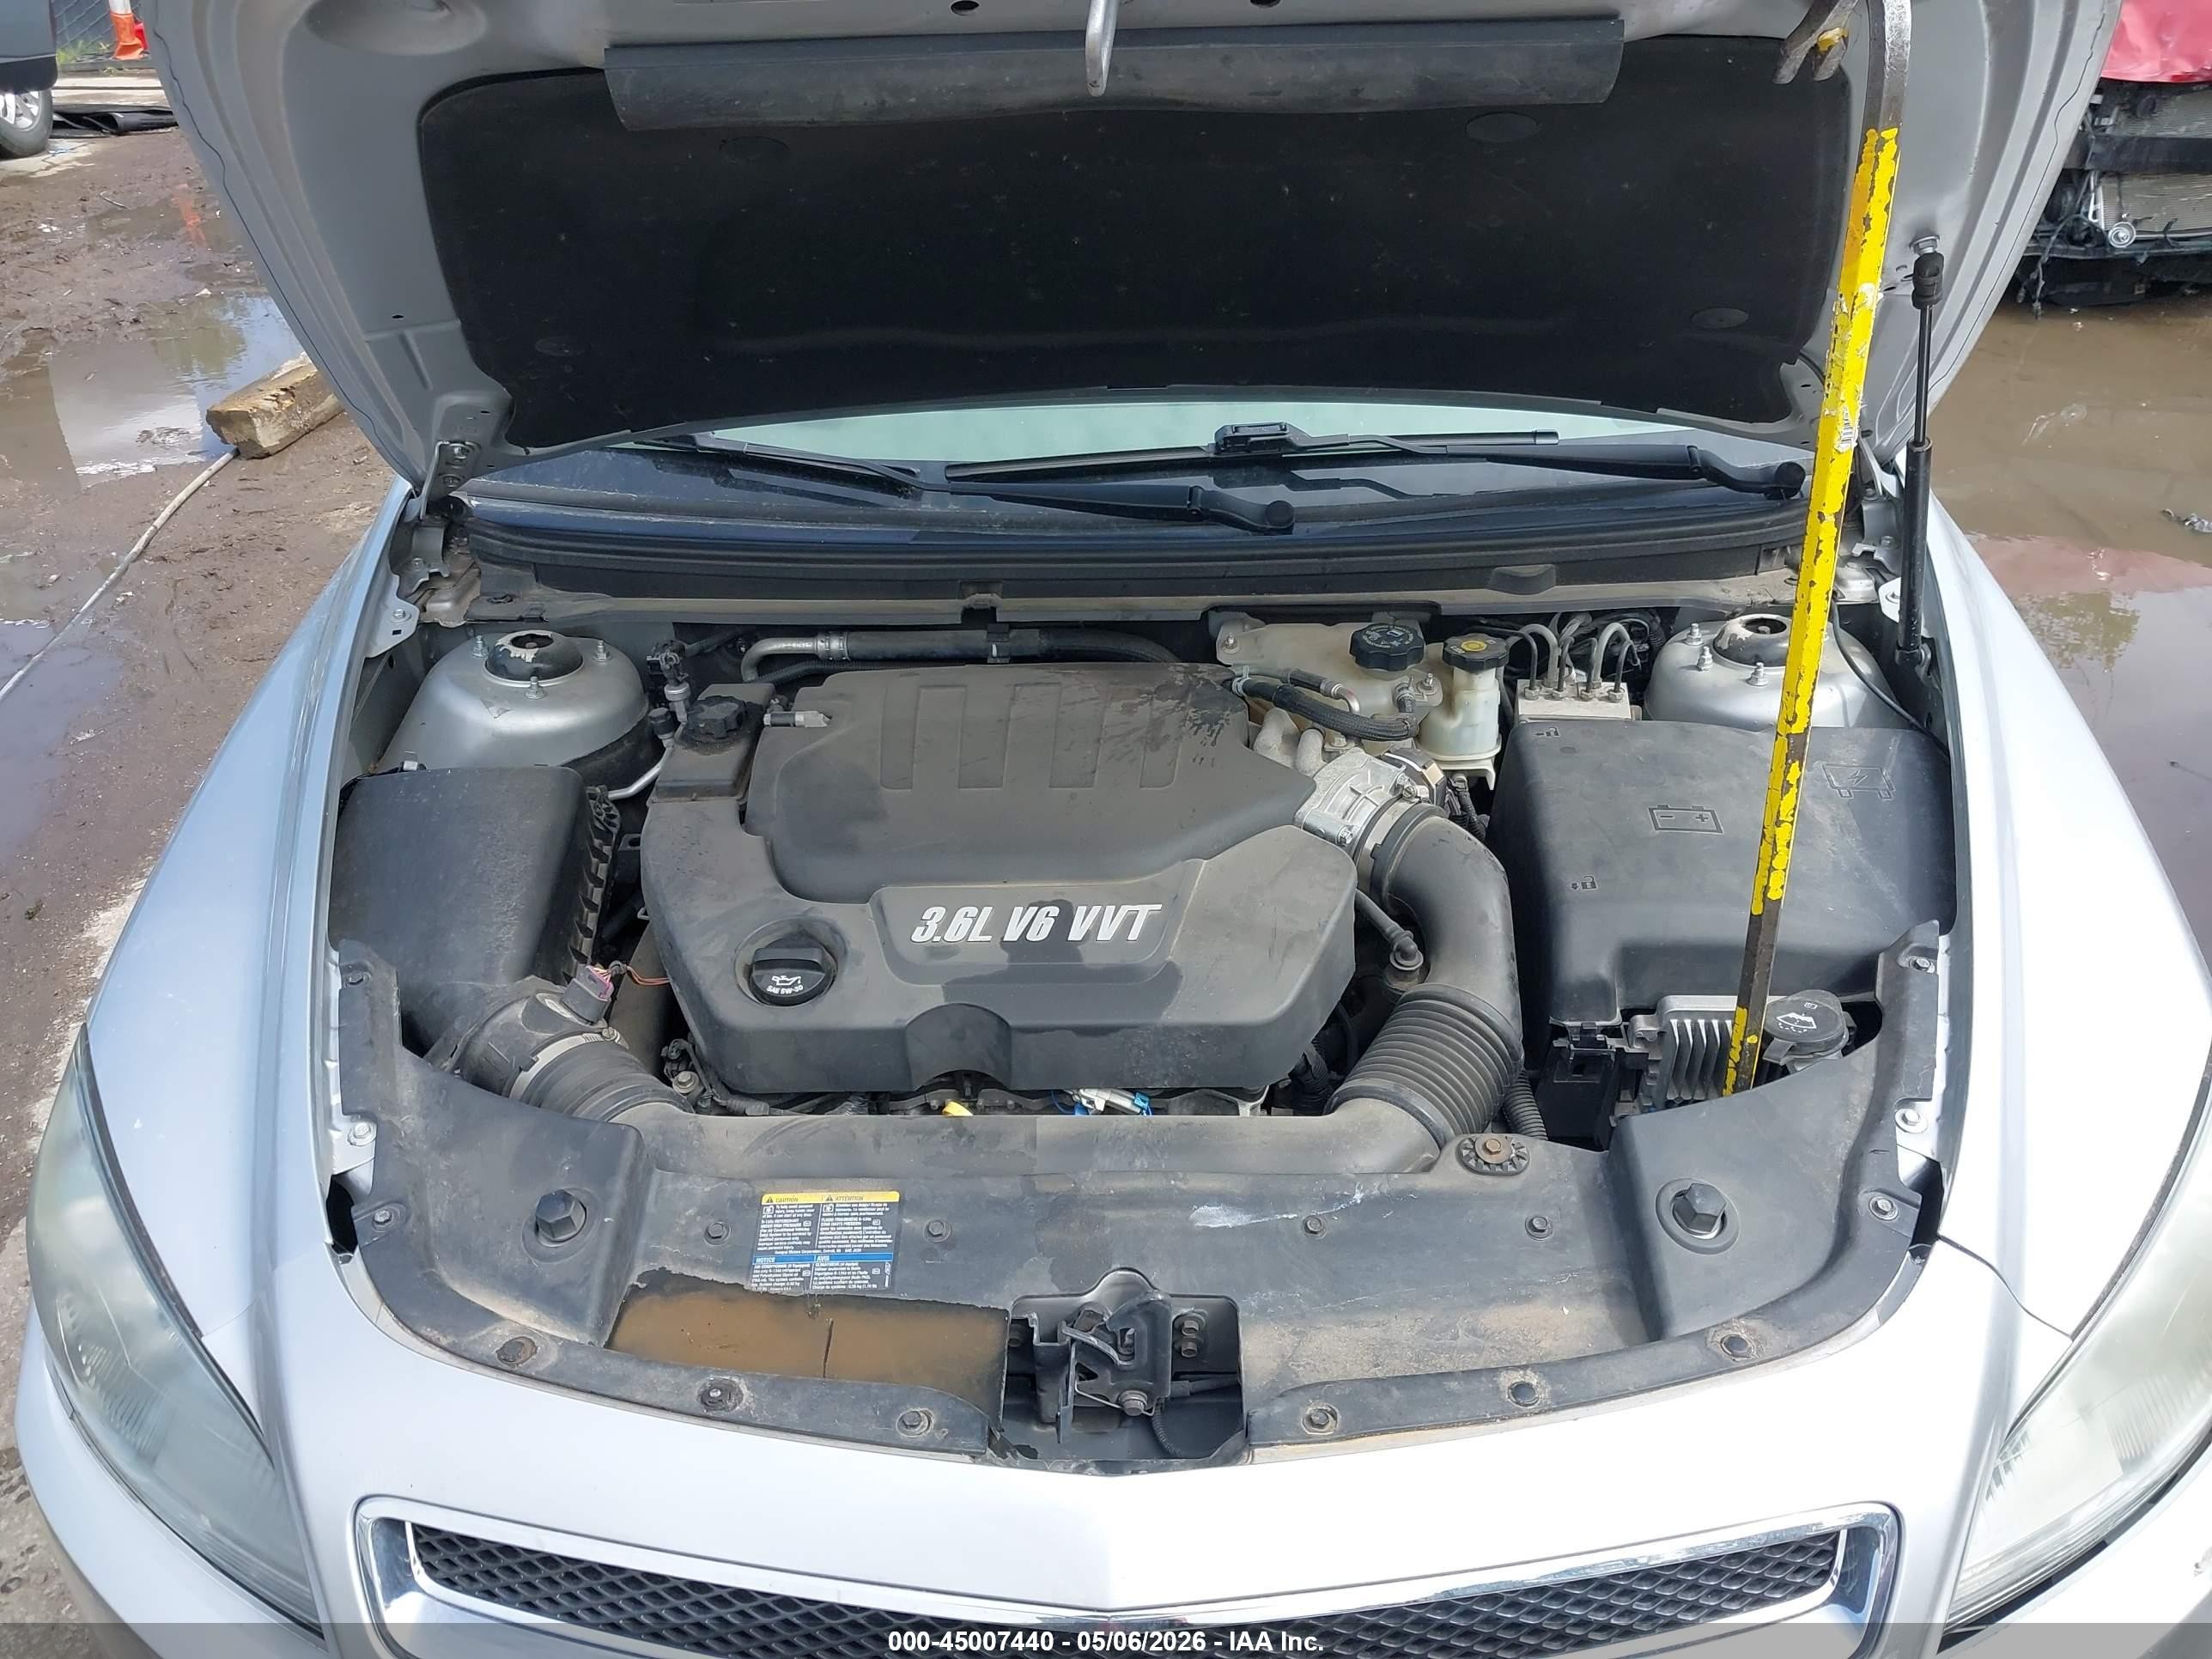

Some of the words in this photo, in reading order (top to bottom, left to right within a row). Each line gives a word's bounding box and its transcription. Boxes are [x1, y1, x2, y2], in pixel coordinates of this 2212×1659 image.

[911, 906, 994, 943] 3.6L
[1002, 906, 1060, 942] V6
[1067, 904, 1163, 942] VVT
[766, 985, 781, 994] SAE
[781, 985, 804, 994] 5W-30
